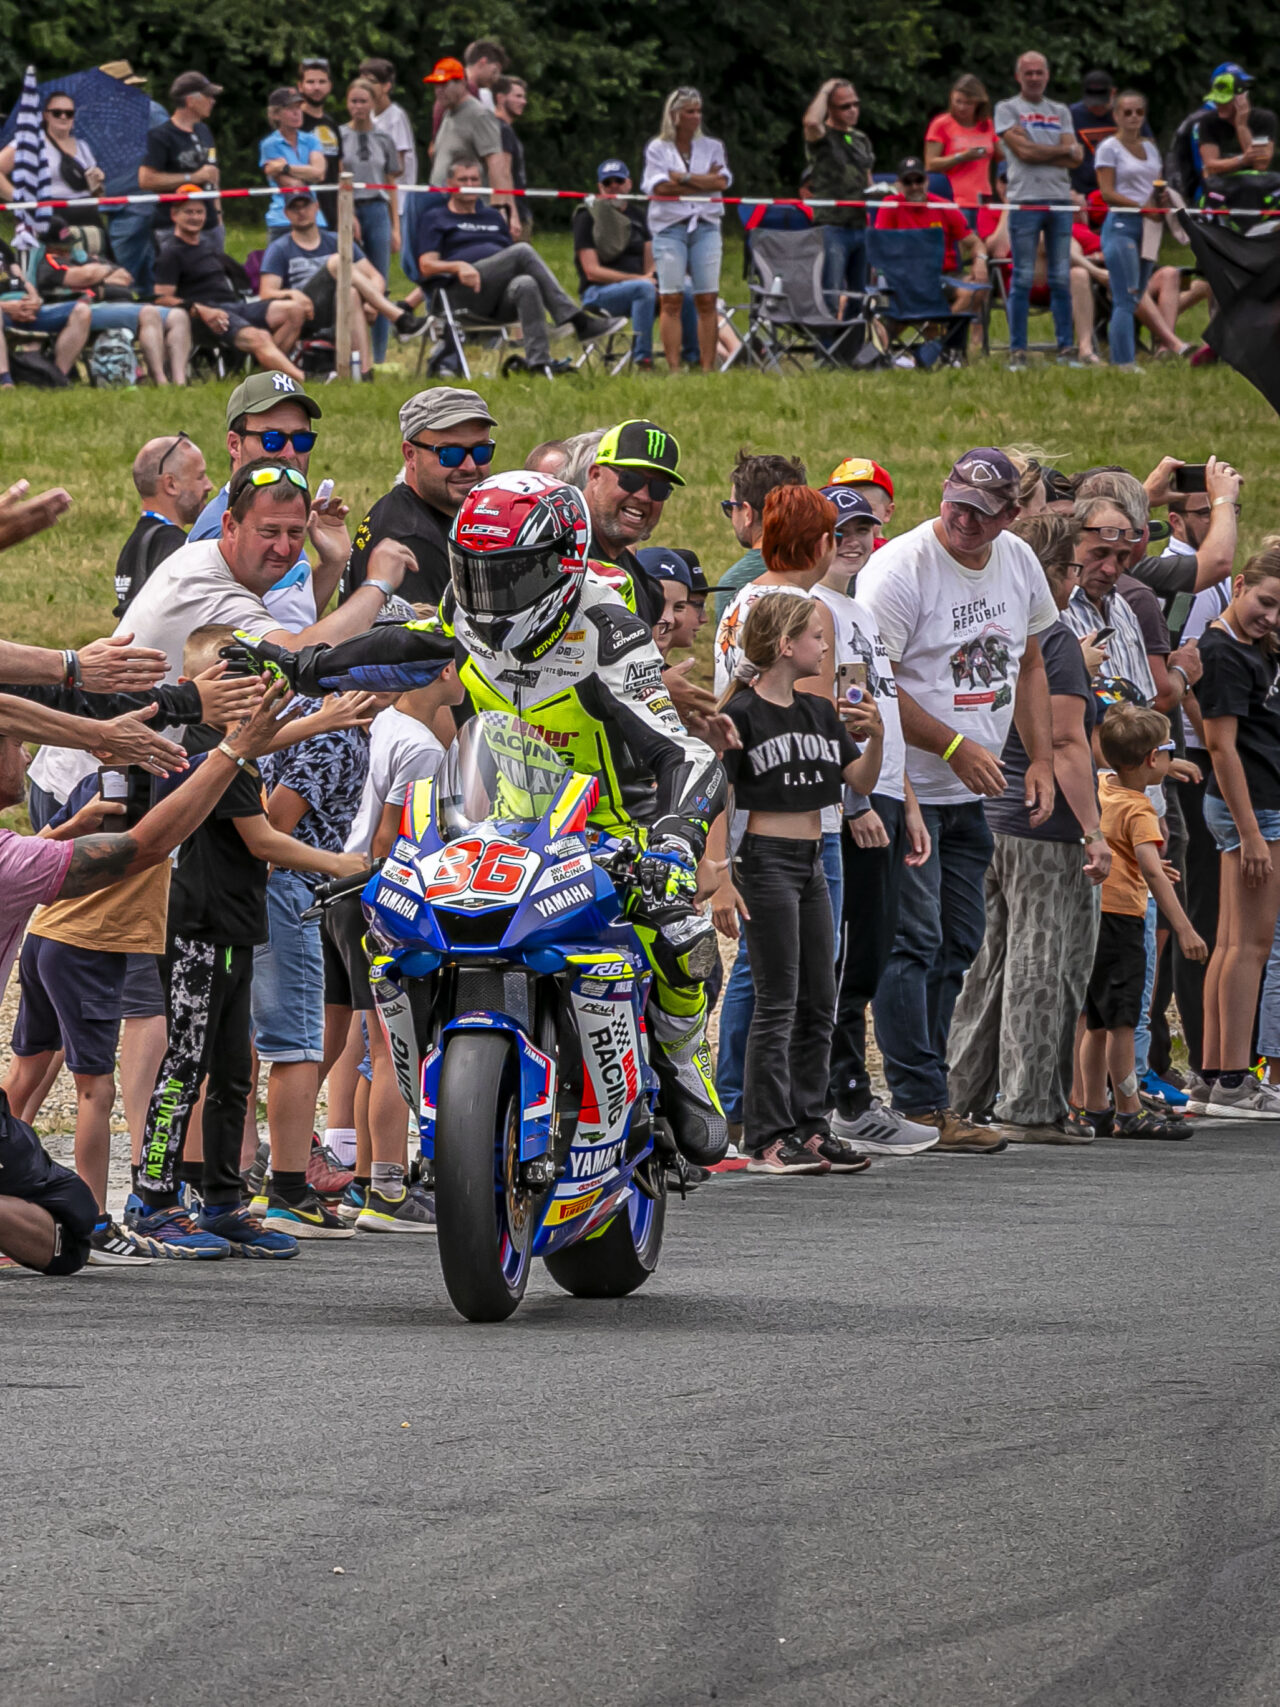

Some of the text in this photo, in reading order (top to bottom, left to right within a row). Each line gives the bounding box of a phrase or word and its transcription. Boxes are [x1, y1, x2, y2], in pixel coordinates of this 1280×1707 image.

[460, 523, 511, 538] LS2
[952, 598, 987, 619] CZECH
[953, 602, 1007, 631] REPUBLIC
[483, 725, 575, 767] RACING
[748, 732, 791, 776] NEW
[424, 838, 531, 902] 36
[552, 864, 587, 883] RACING
[376, 886, 420, 921] YAMAHA
[533, 882, 593, 918] YAMAHA
[523, 1044, 547, 1070] YAMAHA
[587, 1026, 627, 1129] RACING
[147, 1131, 169, 1179] CREW
[559, 1194, 596, 1219] PIRELLI
